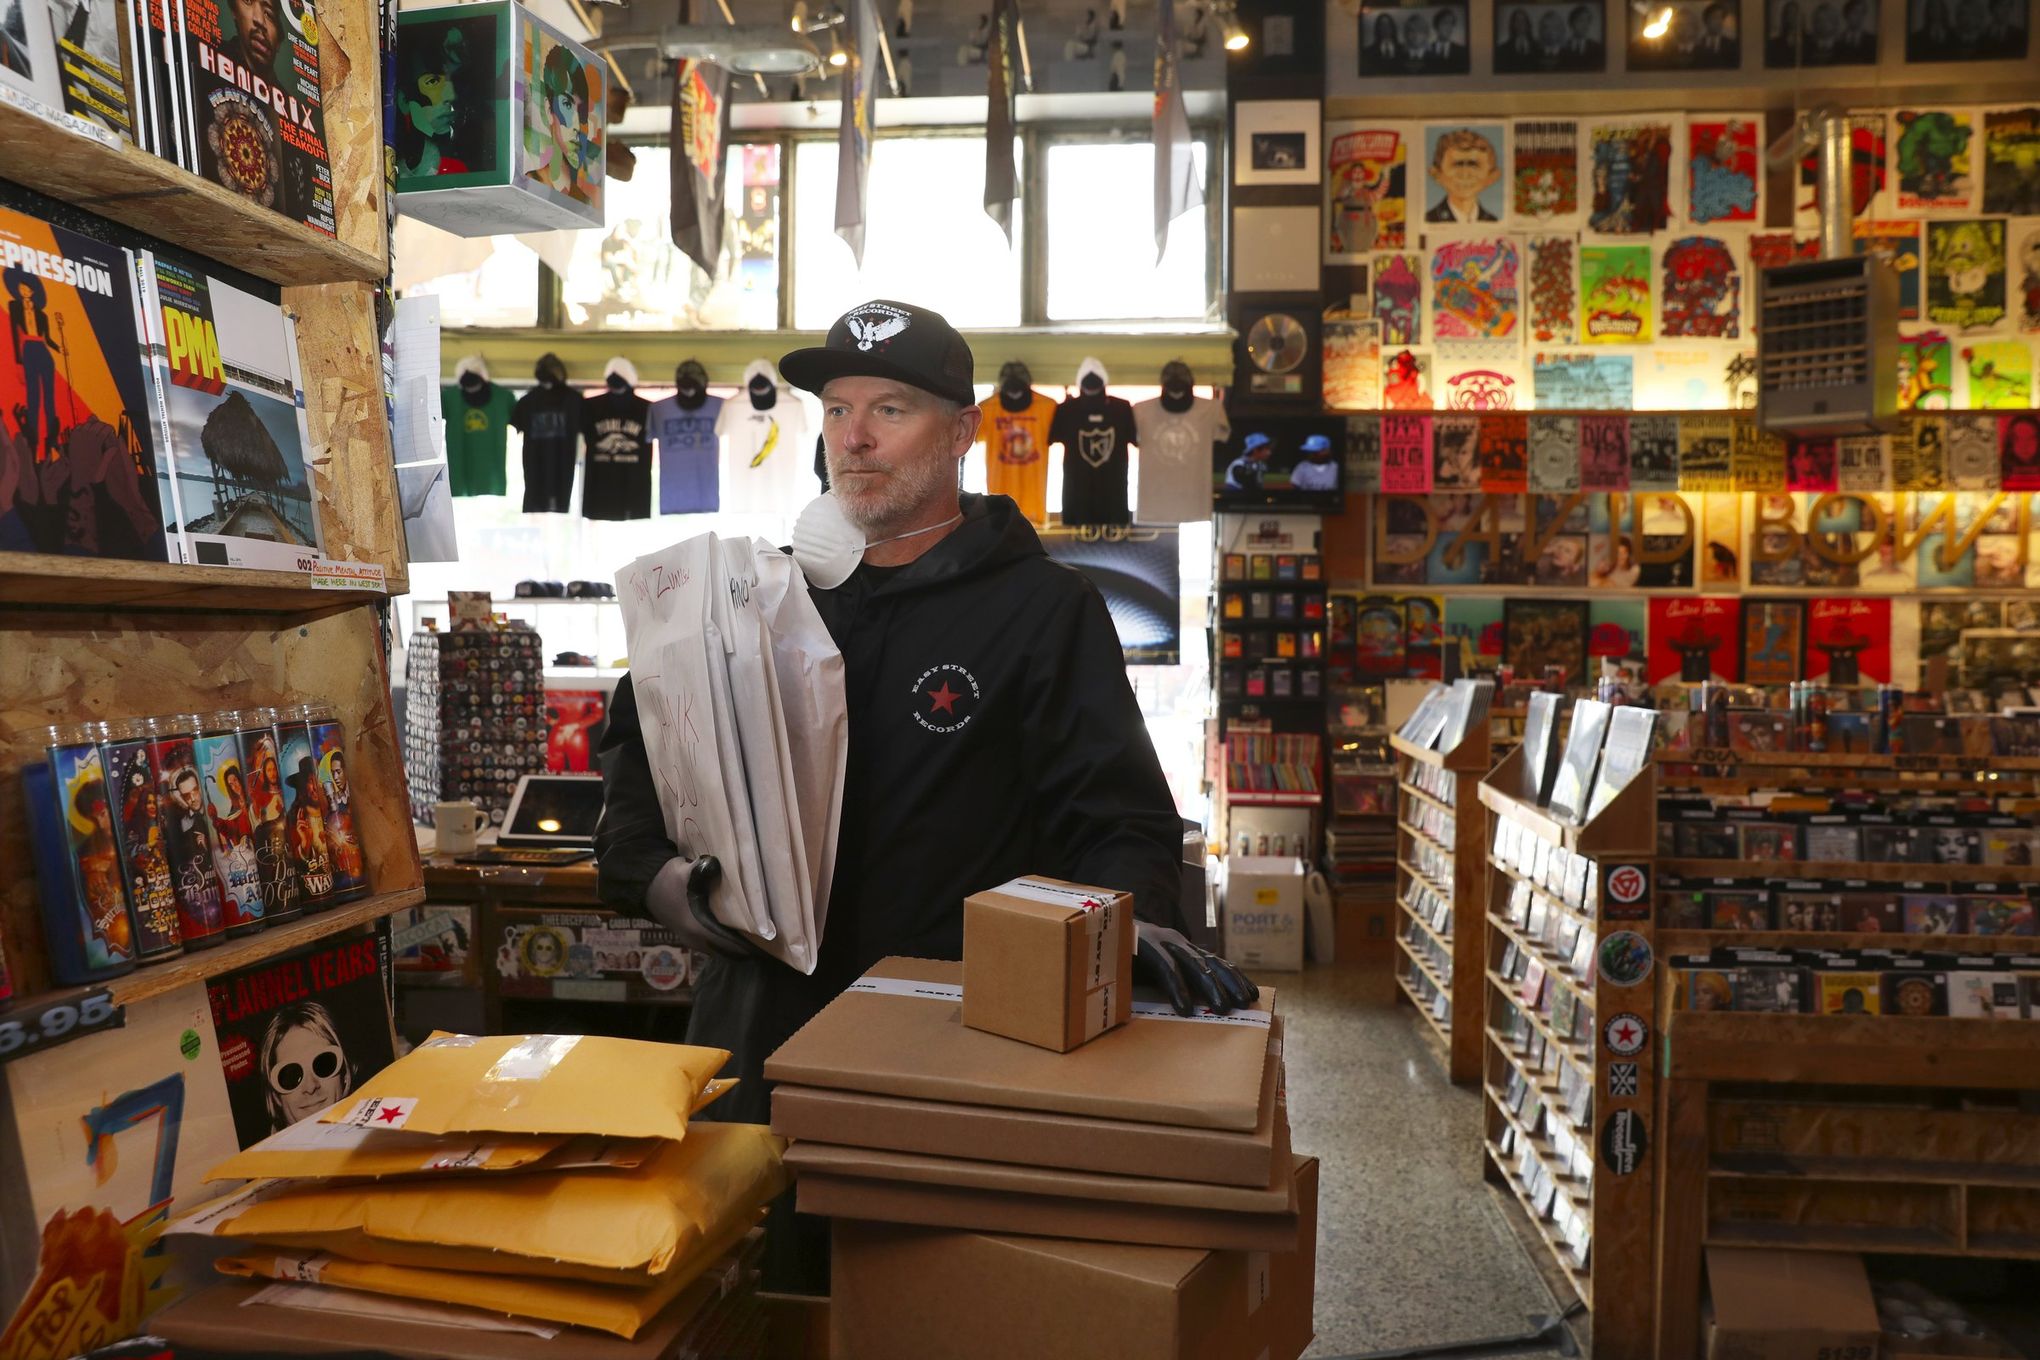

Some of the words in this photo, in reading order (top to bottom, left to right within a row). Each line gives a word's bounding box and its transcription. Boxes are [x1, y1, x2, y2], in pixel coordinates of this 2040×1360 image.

[299, 127, 325, 151] FINAL
[315, 163, 331, 177] PETER
[869, 303, 912, 316] STREET
[163, 305, 227, 385] PMA
[664, 418, 714, 436] SUB
[297, 558, 312, 571] 002
[911, 665, 940, 694] EASY
[942, 664, 980, 700] STREET
[912, 710, 972, 733] RECORDS
[1233, 913, 1277, 925] PORT
[310, 938, 378, 993] YEARS
